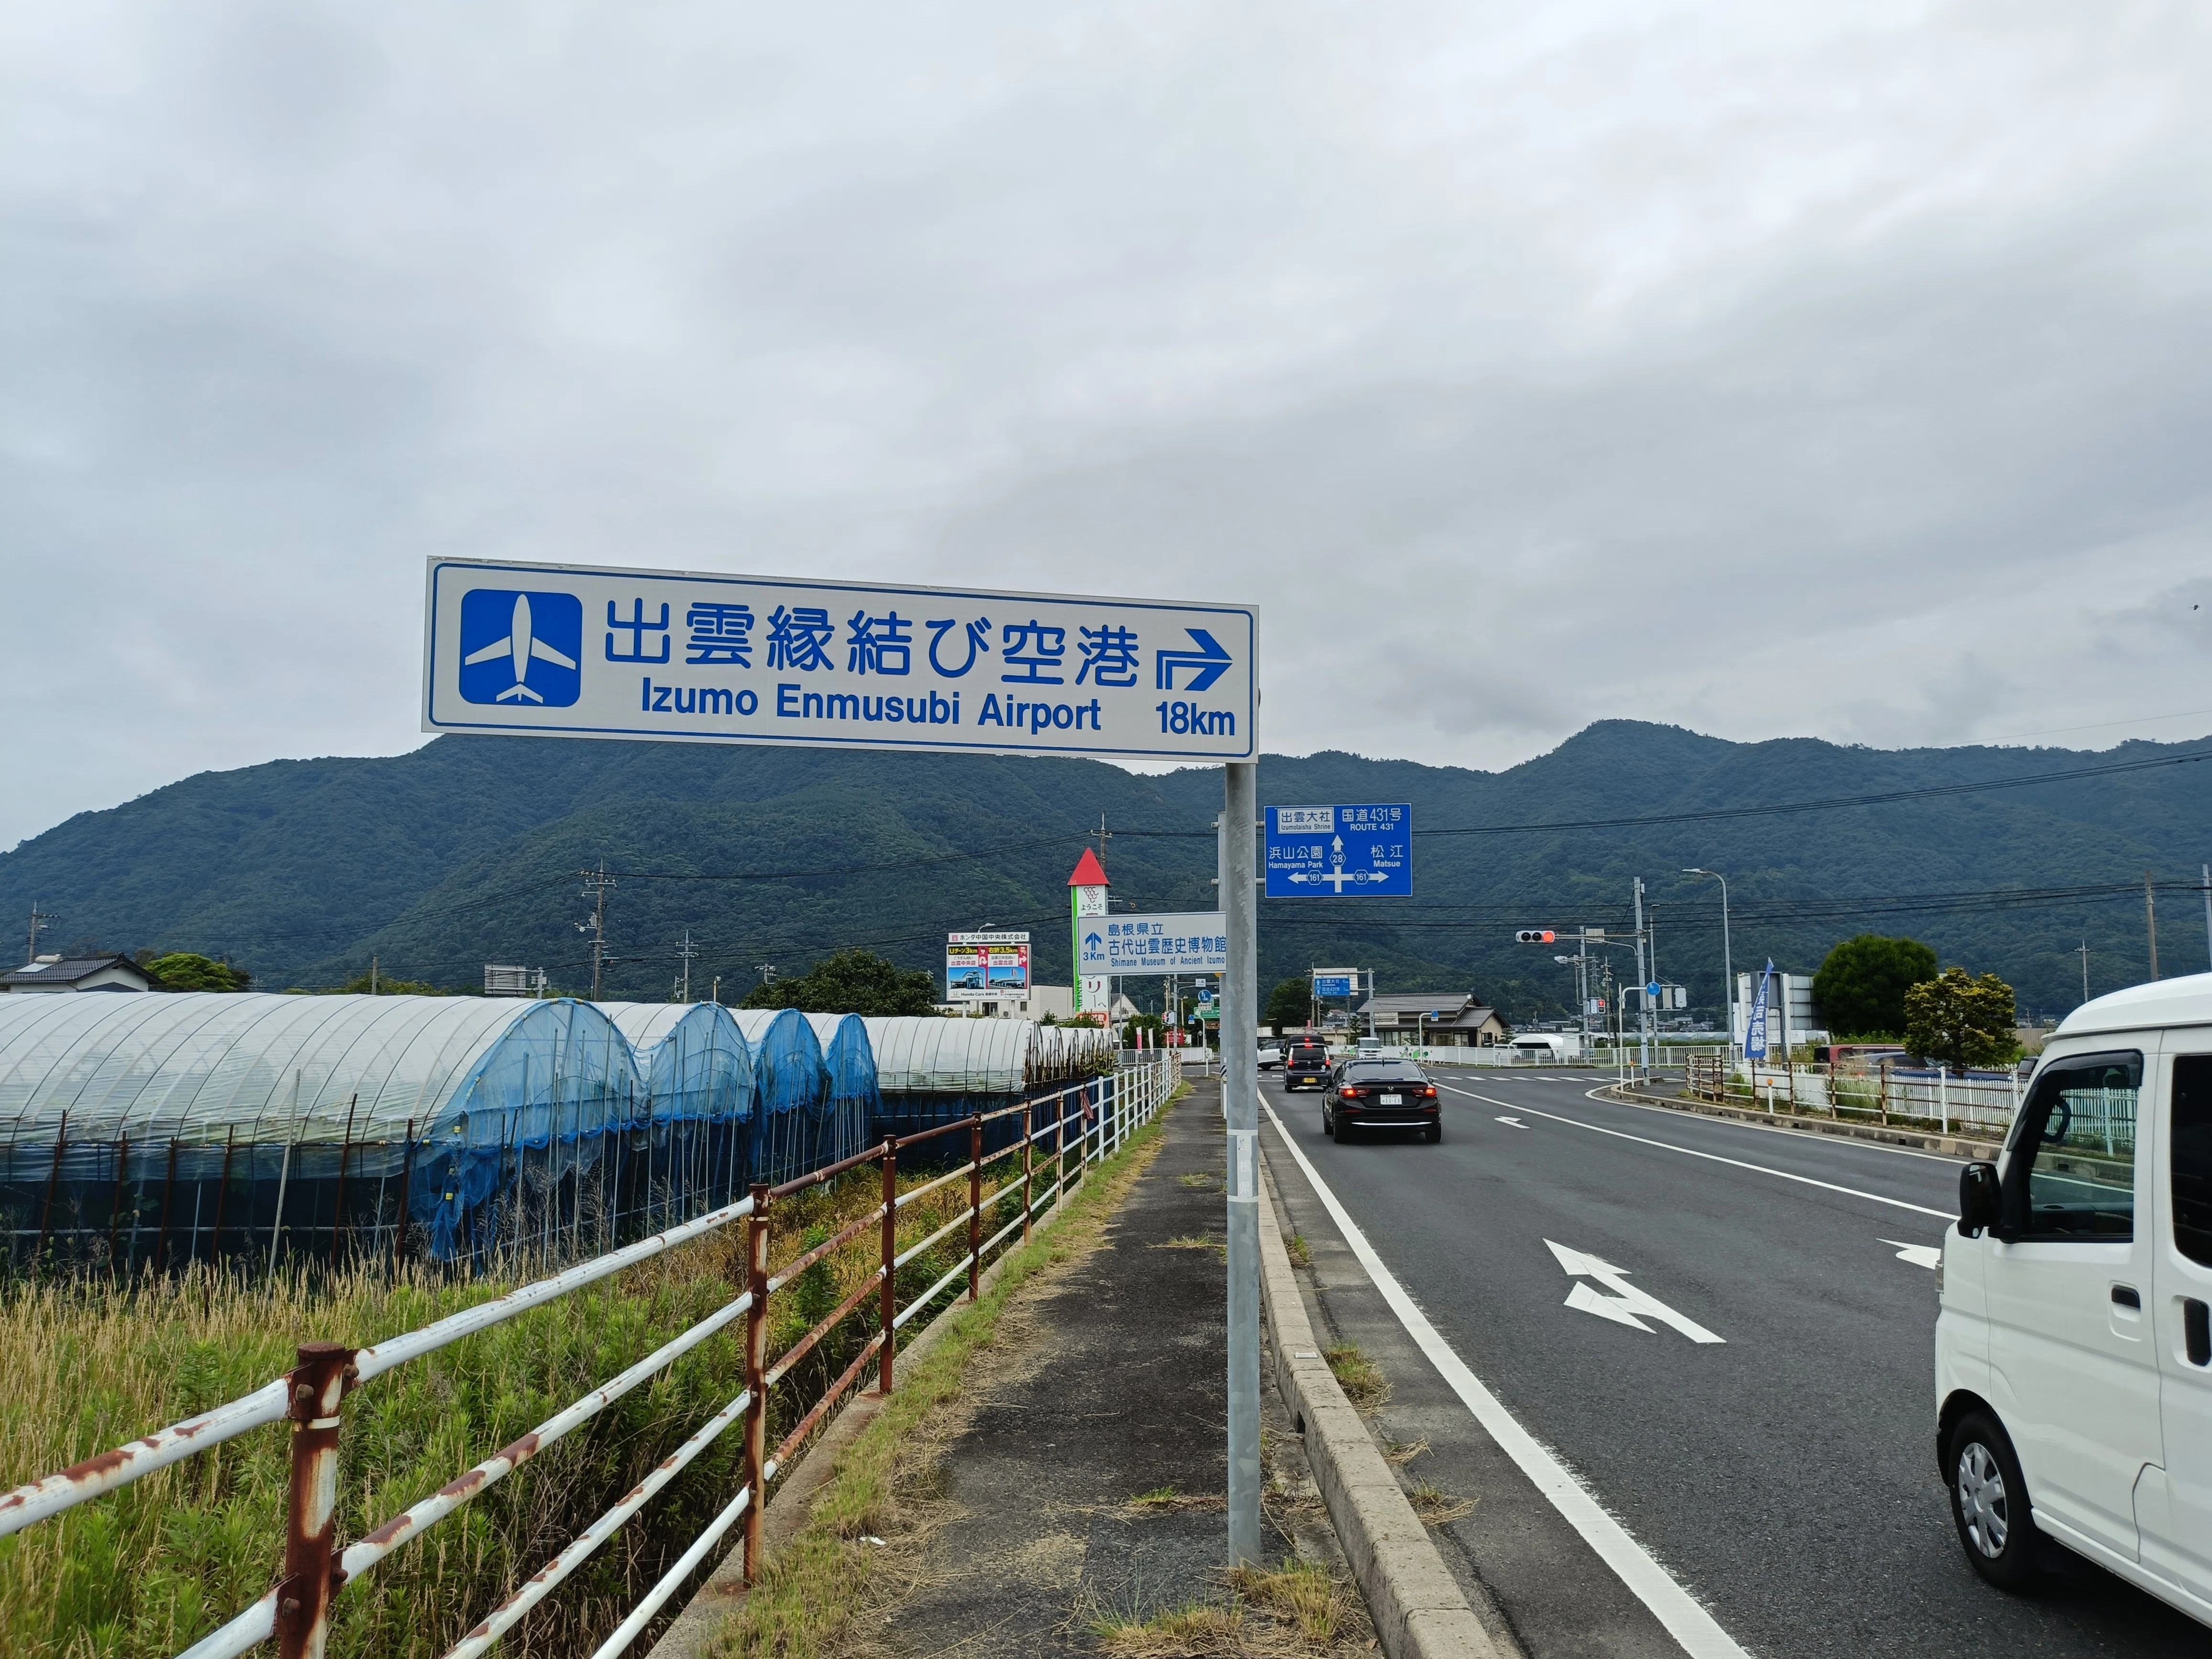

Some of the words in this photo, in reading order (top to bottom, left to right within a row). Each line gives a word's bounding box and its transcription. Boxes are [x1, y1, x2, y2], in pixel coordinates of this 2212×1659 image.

[605, 597, 1140, 687] 出雲縁結び空港
[641, 677, 759, 716] Izumo
[777, 683, 960, 724] Enmusubi
[977, 693, 1101, 735] Airport
[1156, 701, 1235, 736] 18km
[1282, 811, 1330, 823] 出雲大社
[1342, 807, 1402, 822] 国道431号
[1269, 846, 1322, 860] 浜山公園
[1371, 845, 1403, 858] 松江
[1333, 854, 1343, 863] 28
[1269, 862, 1305, 870] Hamayama
[1108, 923, 1164, 936] 島根県立
[1108, 936, 1226, 956] 古代出雲歴史博物館
[1111, 958, 1137, 967] Shimane
[1141, 957, 1166, 966] Museum
[1170, 957, 1176, 965] of
[1180, 956, 1203, 965] Ancient
[1207, 955, 1225, 964] Izumo
